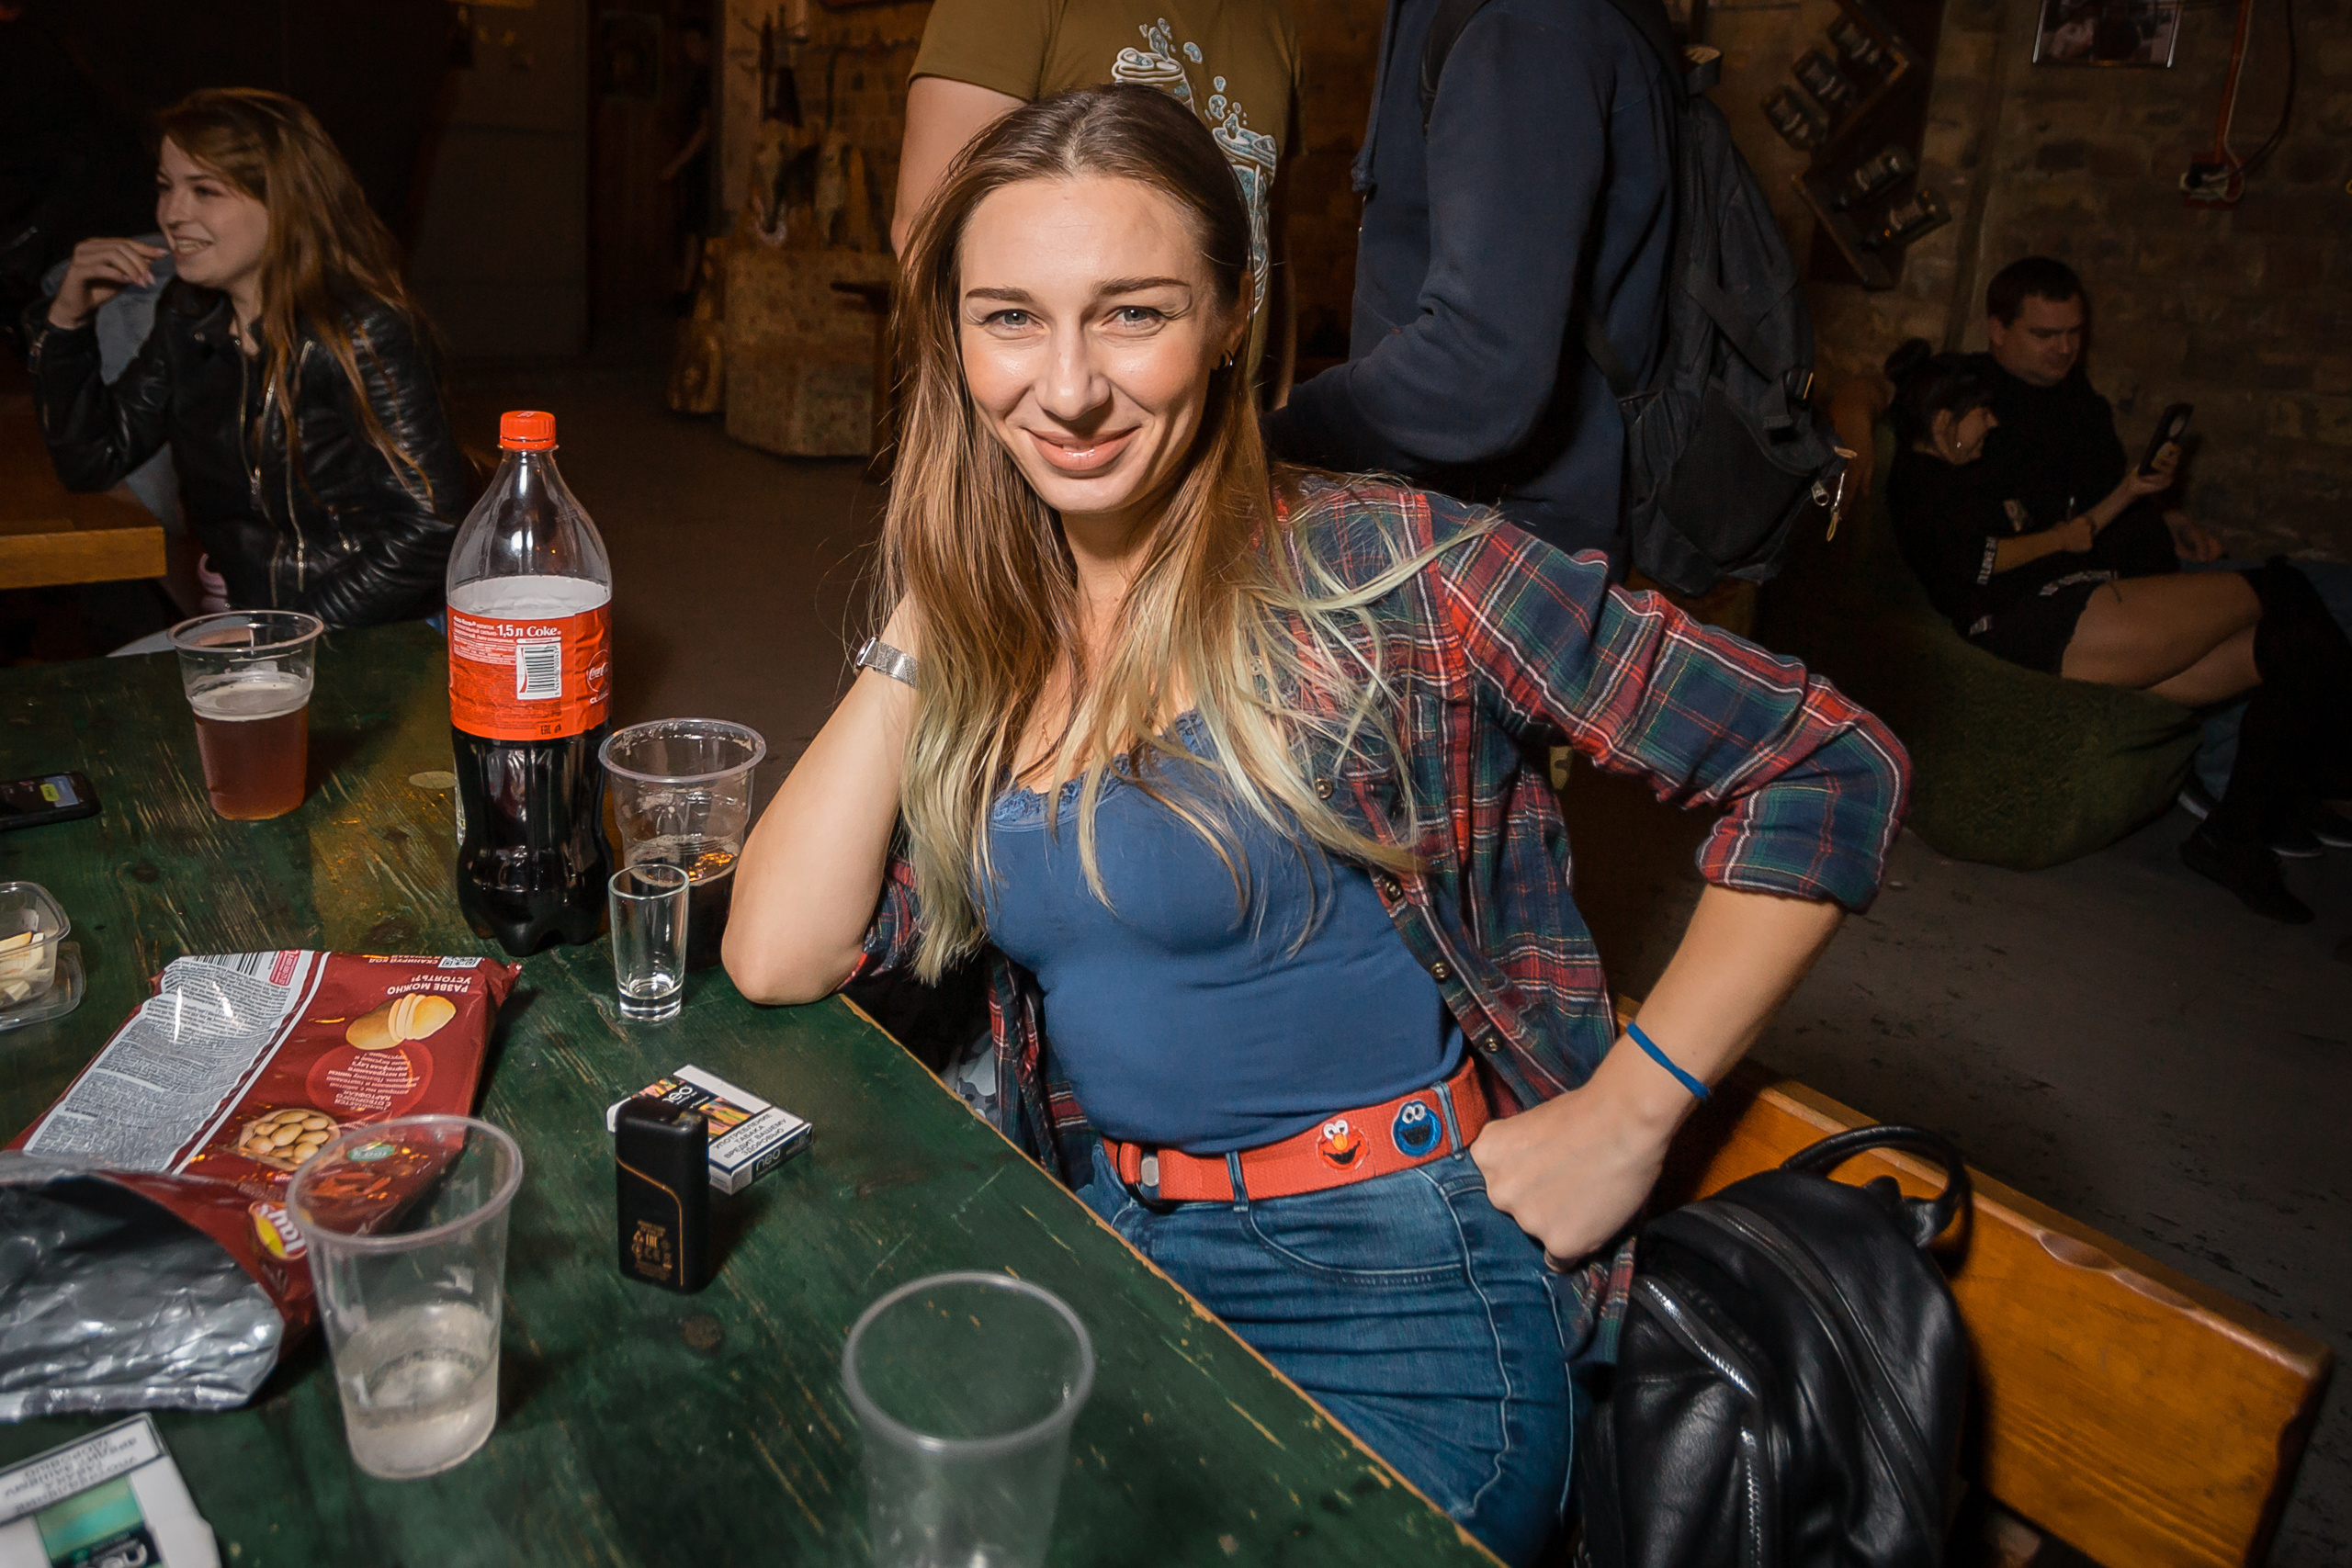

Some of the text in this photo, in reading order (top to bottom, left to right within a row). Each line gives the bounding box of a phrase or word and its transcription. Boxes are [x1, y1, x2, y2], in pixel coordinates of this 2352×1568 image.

[497, 625, 514, 637] 1,5
[387, 983, 469, 995] РАЗВЕ МОЖНО
[714, 1113, 772, 1149] УПОТРЕБЛЕНИЕ
[724, 1119, 786, 1158] ВРЕДИТ ВАШЕМУ
[735, 1125, 764, 1144] ТАБАКА
[741, 1128, 785, 1156] ЗДОРОВЬЮ
[756, 1148, 781, 1171] neo
